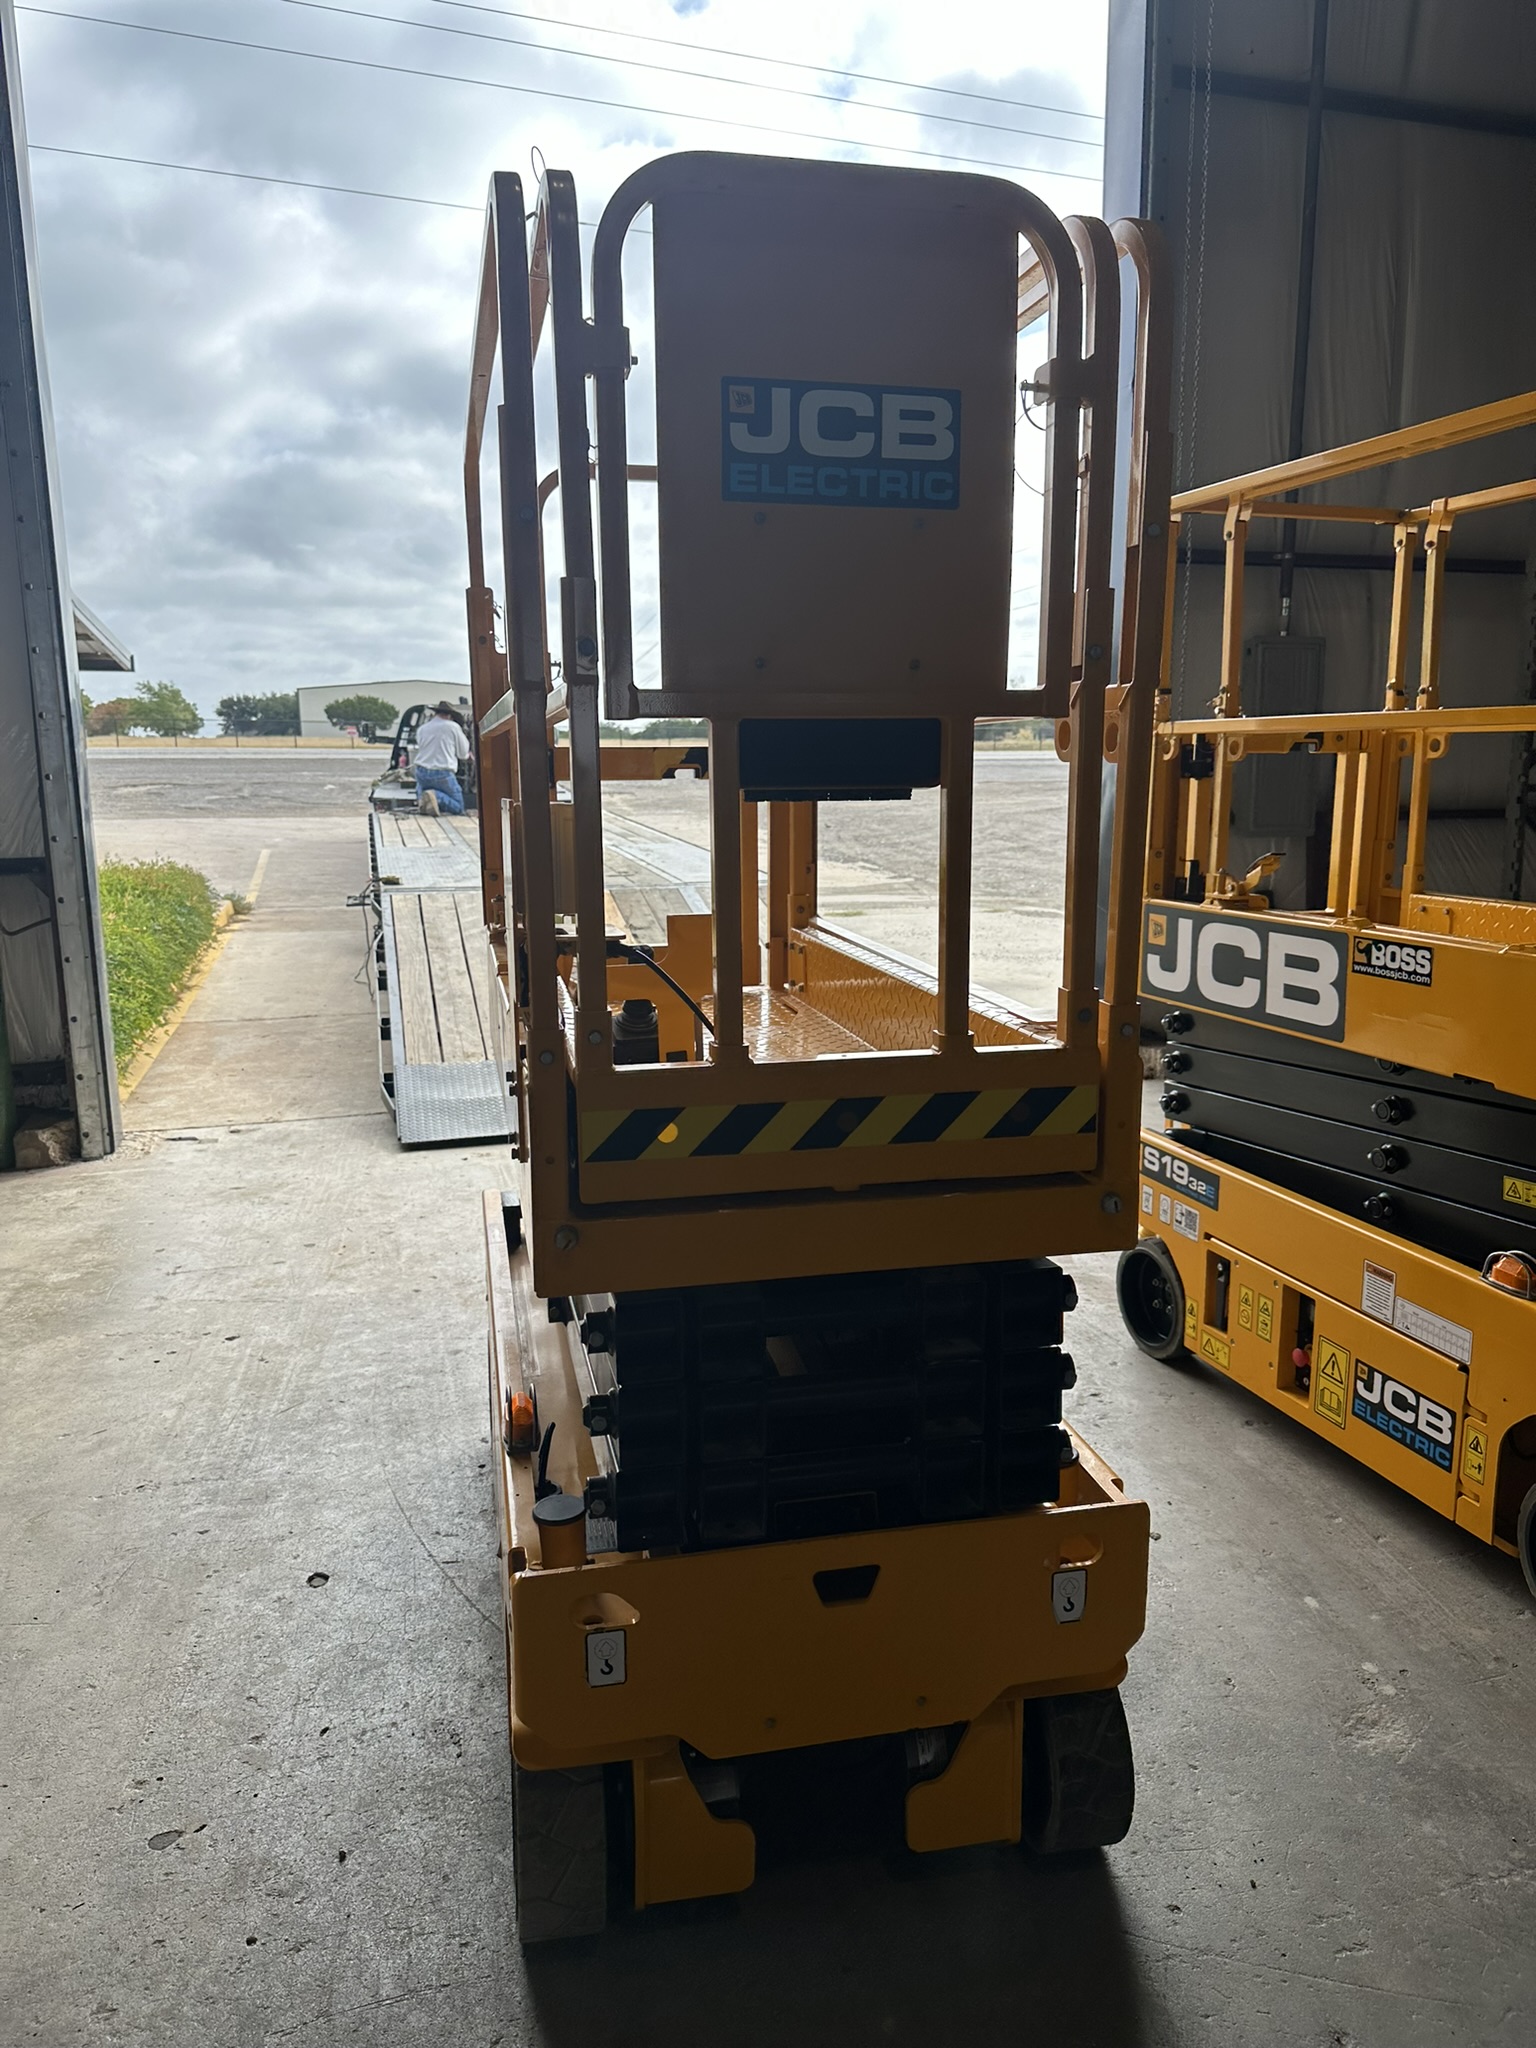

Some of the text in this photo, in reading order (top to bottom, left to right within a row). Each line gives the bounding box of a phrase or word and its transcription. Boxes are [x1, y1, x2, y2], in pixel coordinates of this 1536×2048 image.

[729, 387, 955, 461] JCB
[729, 462, 955, 501] ELECTRIC
[1146, 917, 1340, 1027] JCB
[1353, 964, 1431, 984] www.bossjcb.com
[1371, 943, 1431, 975] BOSS
[1353, 1398, 1450, 1467] ELECTRIC
[1356, 1371, 1453, 1445] JCB
